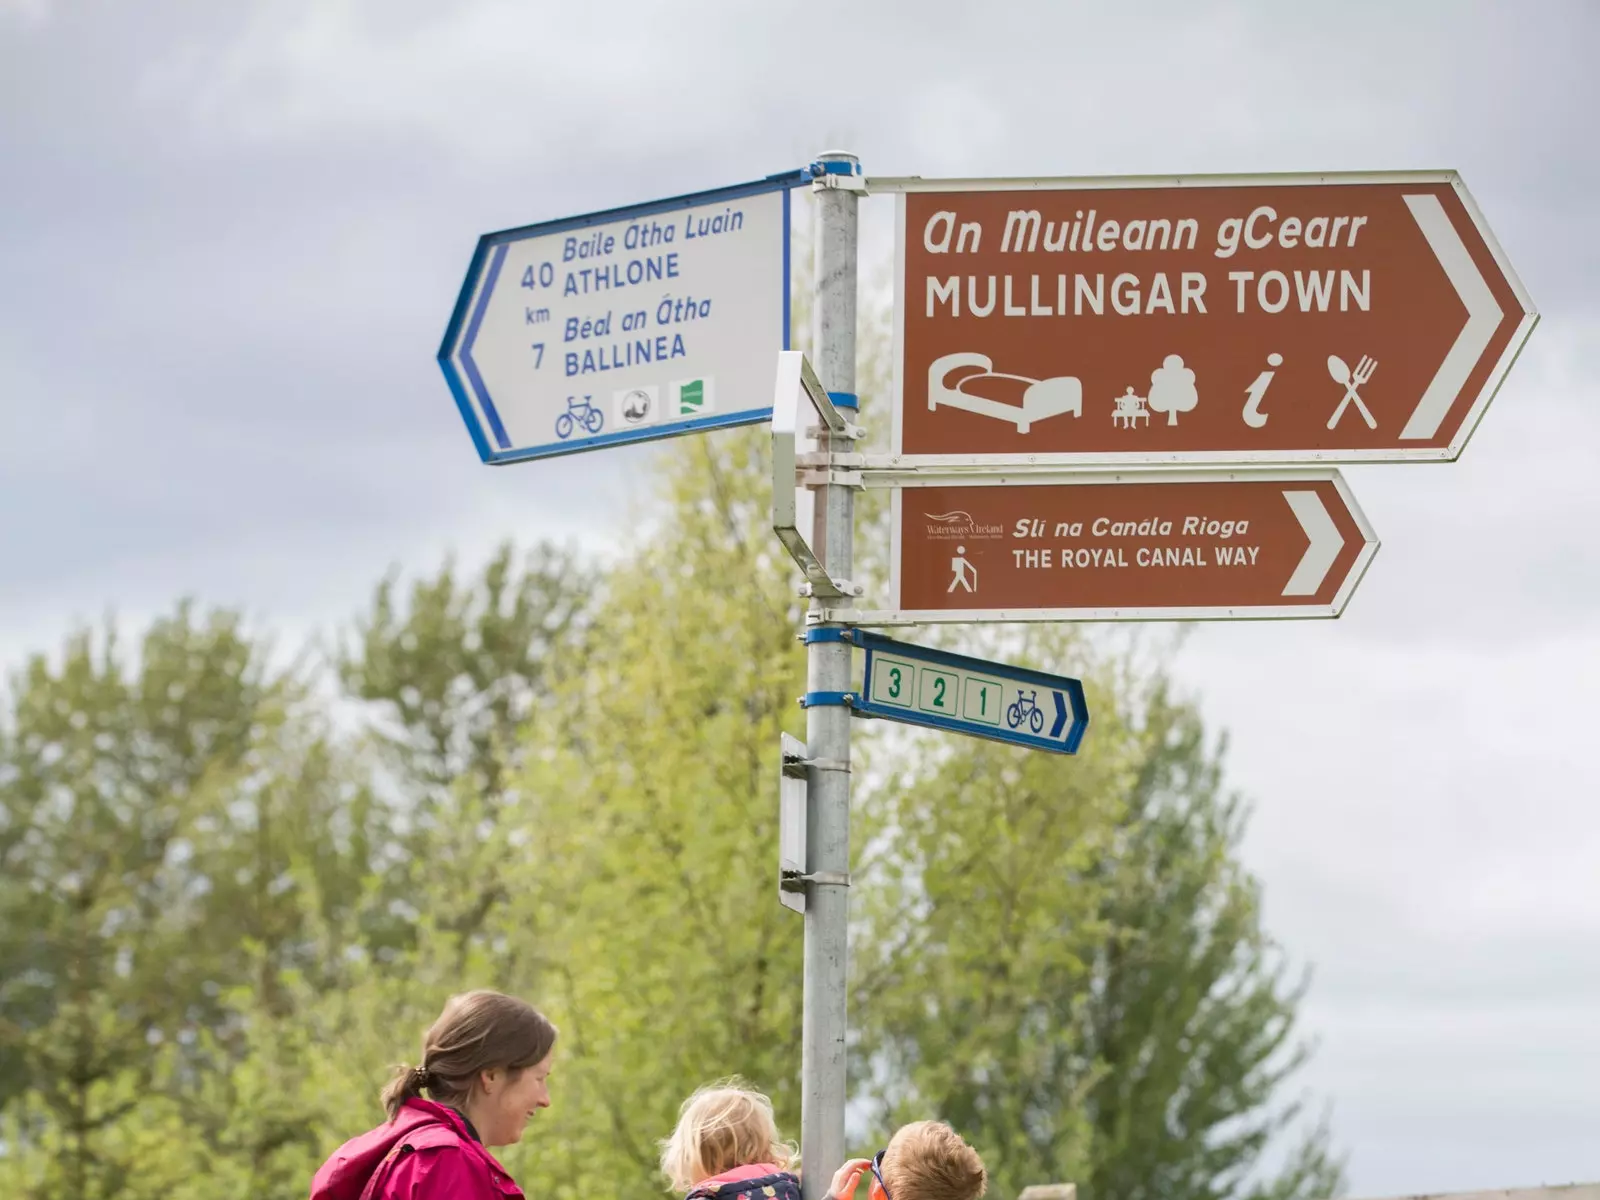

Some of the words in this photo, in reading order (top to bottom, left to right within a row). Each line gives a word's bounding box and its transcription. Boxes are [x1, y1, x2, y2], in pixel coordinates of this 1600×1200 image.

[563, 231, 616, 263] Baile
[684, 207, 744, 240] Luain
[923, 211, 982, 254] An
[1001, 210, 1199, 253] Muileann
[1214, 206, 1368, 259] gCearr
[520, 262, 554, 291] 40
[563, 253, 680, 297] ATHLONE
[926, 272, 1208, 318] MULLINGAR
[1229, 269, 1371, 314] TOWN
[525, 306, 550, 326] km
[564, 310, 612, 343] Béal
[621, 310, 648, 332] an
[656, 293, 712, 326] Átha
[531, 342, 546, 370] 7
[565, 333, 686, 377] BALLINEA
[1012, 518, 1047, 538] Slí
[1054, 522, 1083, 537] na
[1091, 517, 1173, 537] Canála
[1013, 549, 1052, 569] THE
[1061, 548, 1129, 568] ROYAL
[1136, 547, 1207, 567] CANAL
[1214, 546, 1260, 566] WAY
[888, 668, 901, 698] 3
[933, 677, 945, 707] 2
[980, 686, 987, 716] 1
